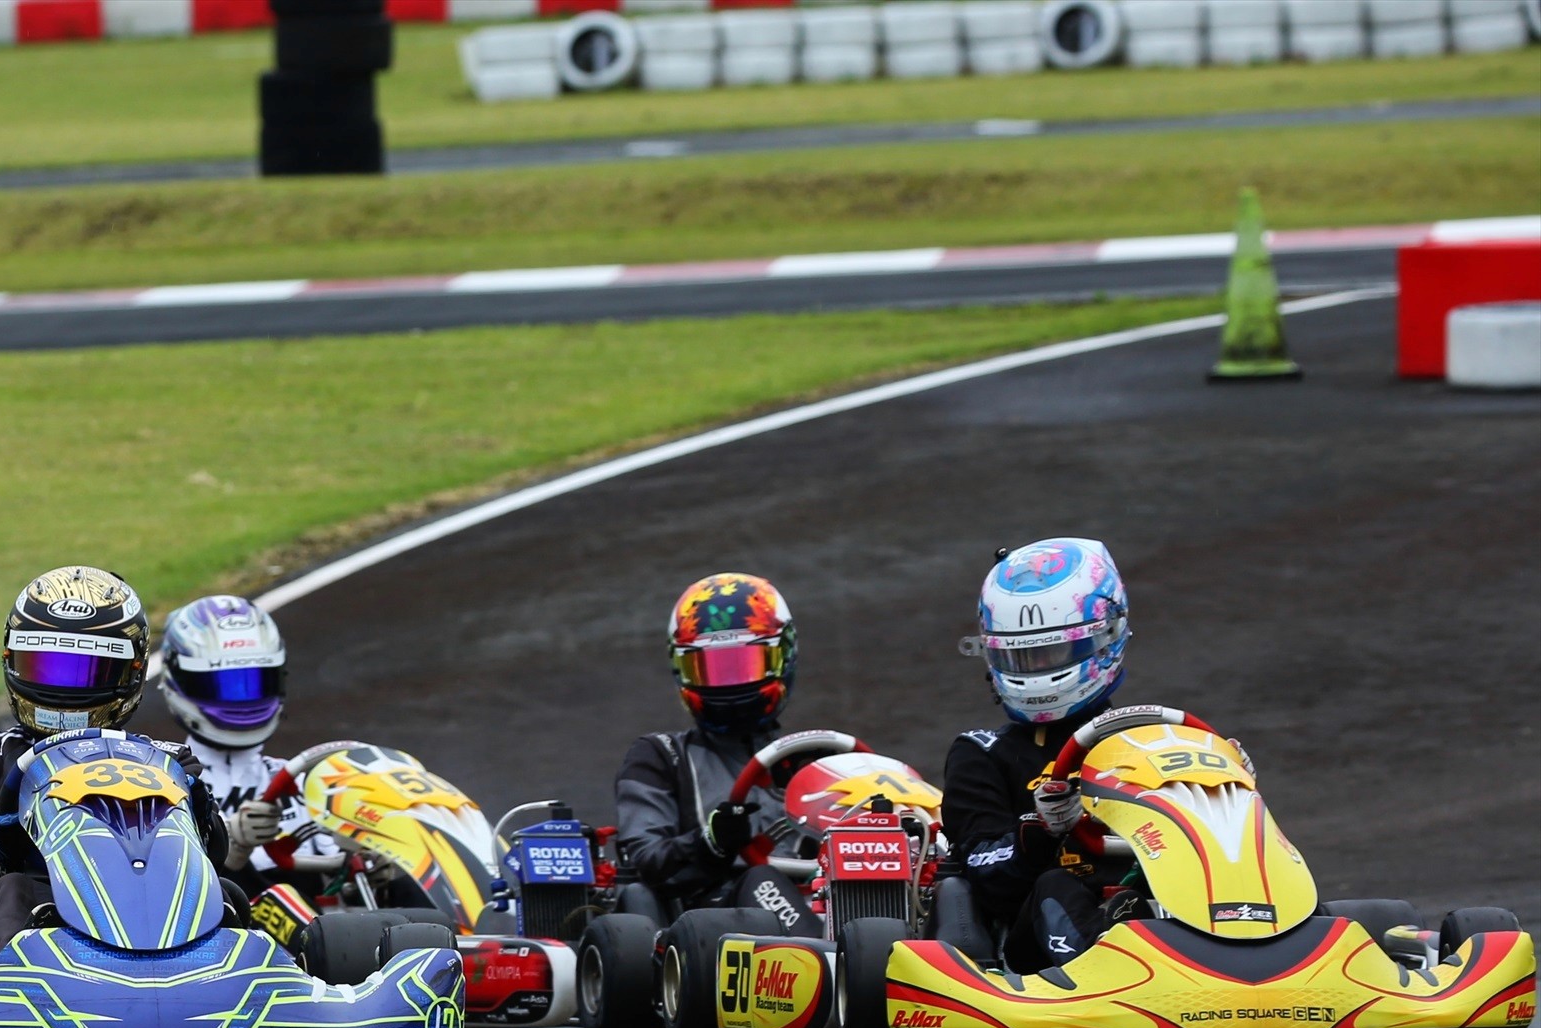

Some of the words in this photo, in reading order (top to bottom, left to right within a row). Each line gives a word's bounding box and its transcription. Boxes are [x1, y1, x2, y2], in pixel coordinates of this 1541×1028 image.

[58, 600, 90, 613] Arai
[15, 635, 125, 654] PORSCHE
[1017, 635, 1062, 647] Honda
[1158, 751, 1228, 772] 30
[83, 763, 163, 791] 33
[857, 817, 890, 825] evo
[529, 847, 583, 859] ROTAX
[838, 842, 899, 854] ROTAX
[534, 866, 585, 875] evo
[843, 861, 901, 871] evo
[755, 880, 801, 927] sparco
[486, 965, 522, 980] OLYMPIA
[754, 959, 799, 999] B-Max
[721, 950, 751, 1013] 30
[891, 1009, 947, 1028] B-Max
[1180, 1009, 1233, 1022] RACING
[1236, 1008, 1292, 1020] SQUARE
[1292, 1006, 1336, 1022] GEN
